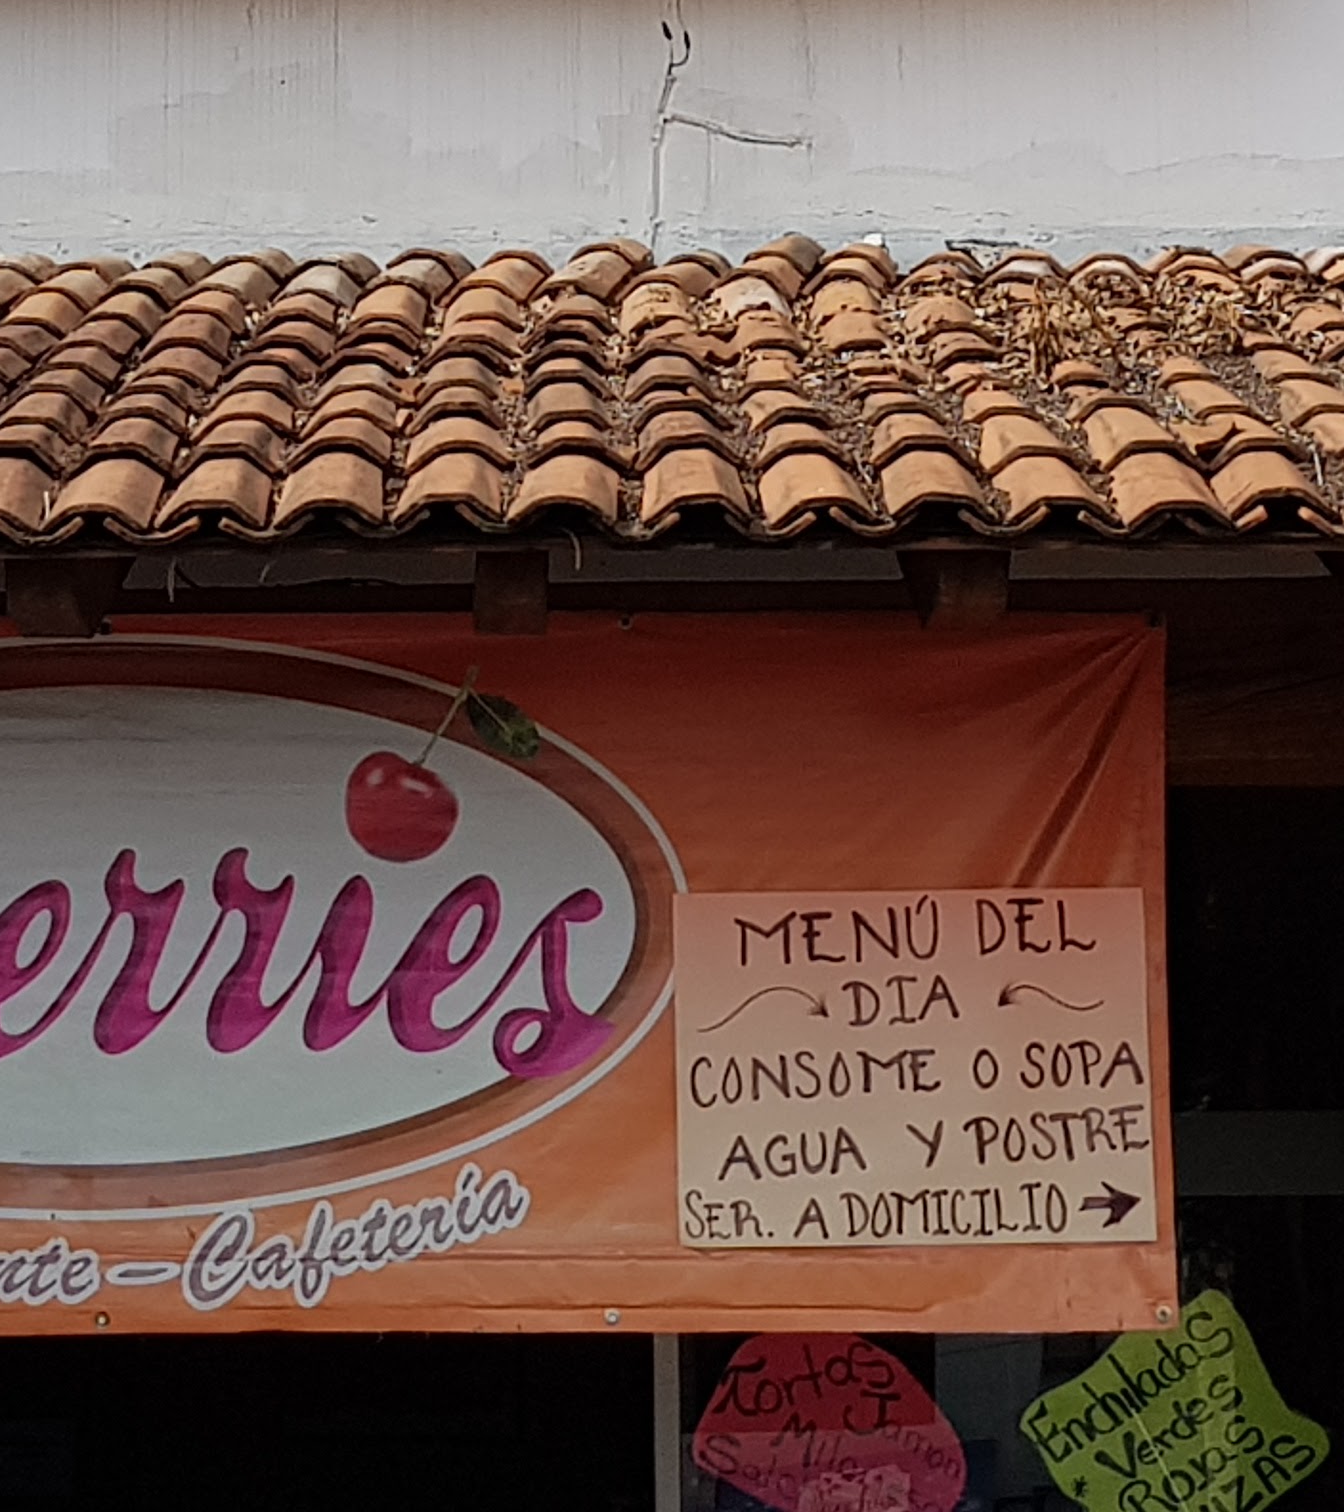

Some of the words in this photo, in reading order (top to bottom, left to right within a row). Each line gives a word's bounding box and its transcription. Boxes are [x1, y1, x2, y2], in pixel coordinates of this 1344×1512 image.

[732, 894, 940, 966] MENÚ
[975, 897, 1097, 956] DEL
[841, 974, 960, 1026] DIA
[689, 1048, 942, 1108] CONSOME
[972, 1048, 999, 1089] O
[1019, 1040, 1146, 1090] SOPA
[718, 1126, 867, 1182] AGUA
[906, 1119, 945, 1169] Y
[962, 1103, 1150, 1165] POSTRE
[190, 1163, 528, 1306] Cafetería
[683, 1188, 775, 1240] SER.
[793, 1197, 830, 1240] A
[840, 1182, 1069, 1239] DOMICILIO
[1027, 1310, 1234, 1464] Enchiladas
[1093, 1373, 1244, 1479] Verdes
